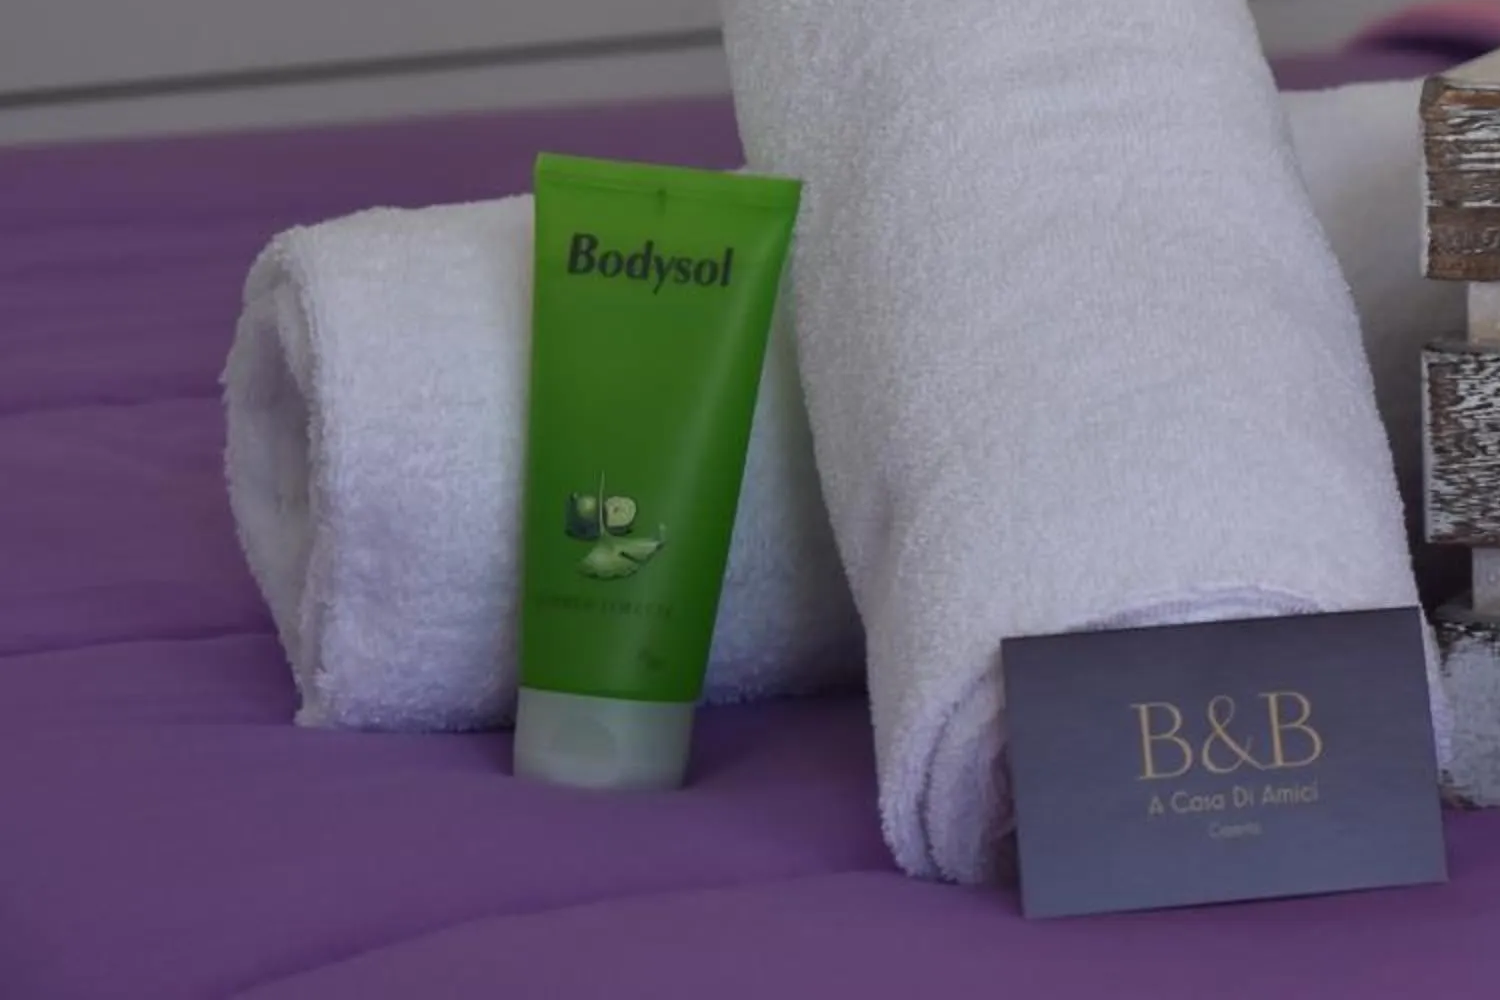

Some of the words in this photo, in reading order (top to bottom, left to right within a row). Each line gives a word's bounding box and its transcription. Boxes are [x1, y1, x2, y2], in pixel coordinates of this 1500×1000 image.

[567, 232, 734, 294] Bodysol
[1130, 690, 1324, 780] B&B
[1148, 796, 1165, 817] A
[1170, 790, 1225, 814] Casa
[1232, 785, 1256, 808] Di
[1261, 776, 1320, 805] Amici
